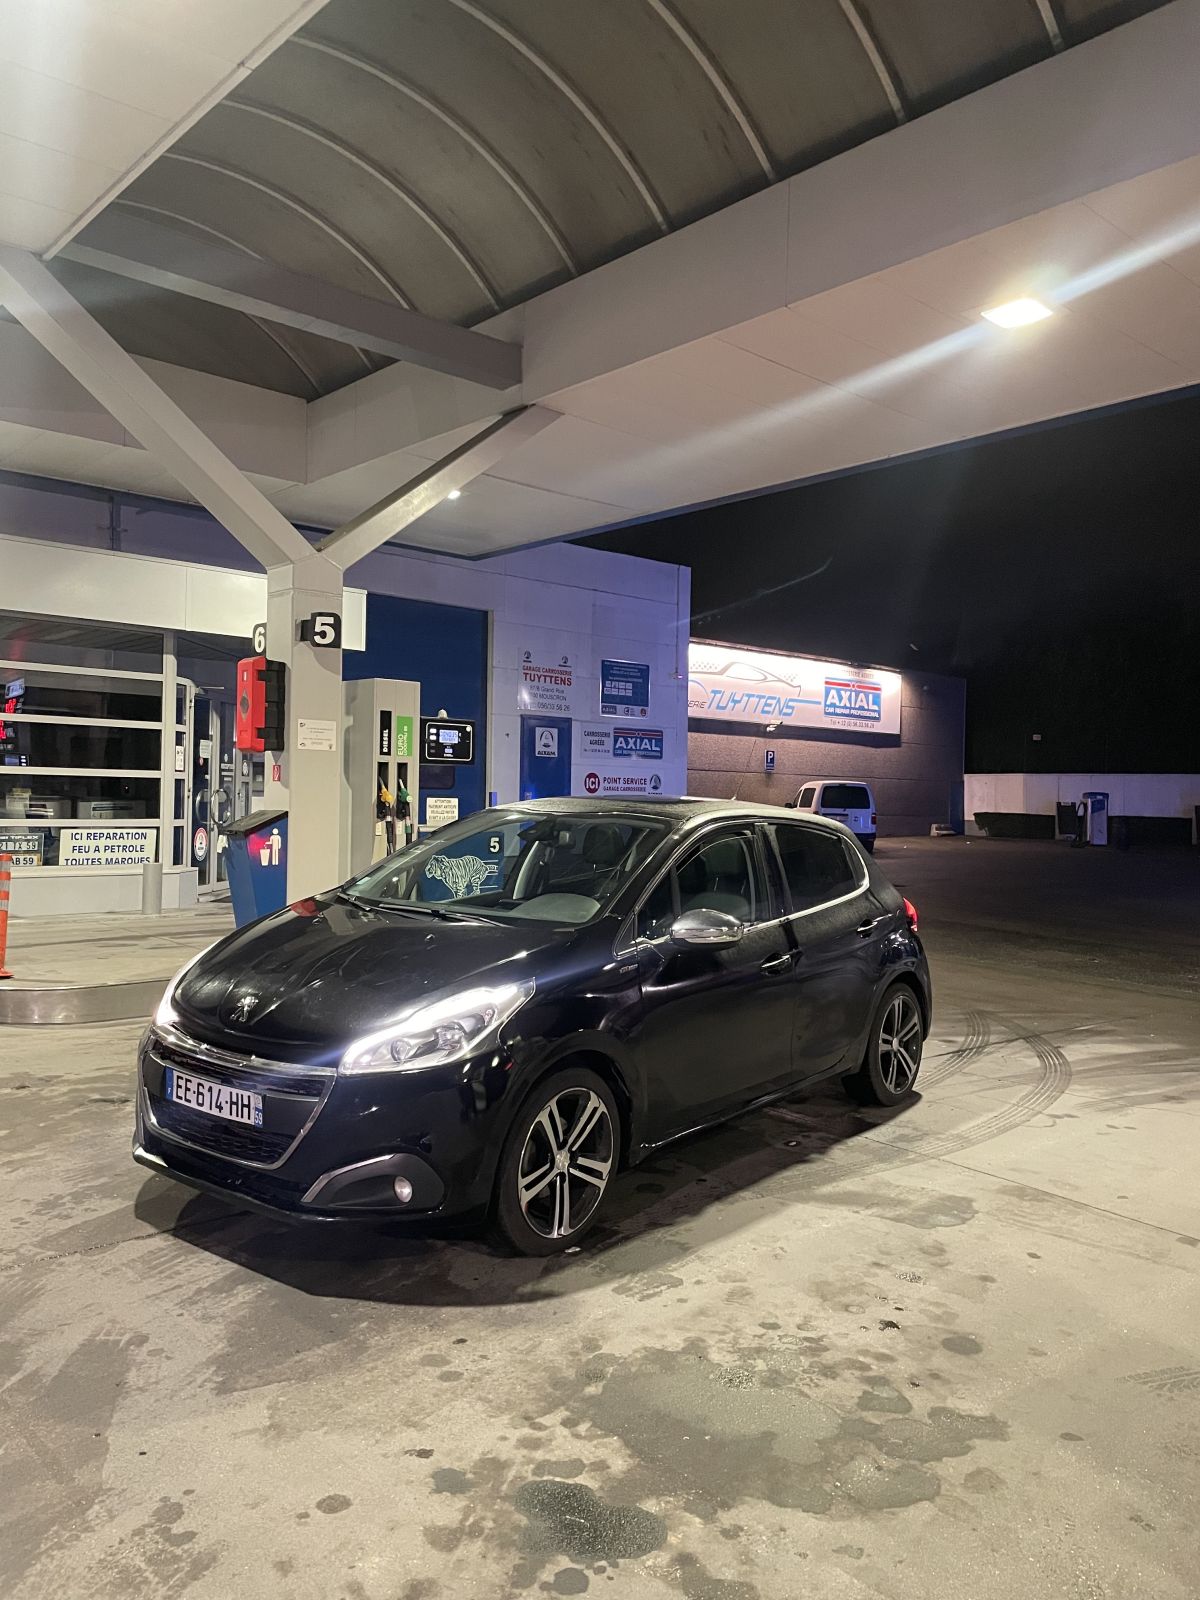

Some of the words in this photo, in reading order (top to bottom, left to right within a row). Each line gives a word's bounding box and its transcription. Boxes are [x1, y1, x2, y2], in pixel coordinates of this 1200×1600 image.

[313, 616, 336, 644] 5
[254, 626, 266, 653] 6
[522, 665, 540, 673] GARAGE
[523, 672, 572, 686] TUYTTENS
[708, 690, 797, 717] TUYTTENS
[826, 689, 878, 710] AXIAL
[615, 737, 661, 751] AXIAL
[768, 752, 773, 762] P
[586, 778, 598, 789] ICI
[71, 832, 83, 841] ICI
[86, 832, 147, 840] REPARATION
[27, 841, 36, 849] 59
[72, 845, 90, 854] FEU
[94, 845, 100, 853] A
[104, 845, 145, 853] PETROLE
[490, 837, 500, 852] 5
[23, 857, 34, 865] 59
[105, 857, 150, 865] MARQUES
[176, 1075, 251, 1120] EE-614-HH
[254, 1110, 262, 1124] 59
